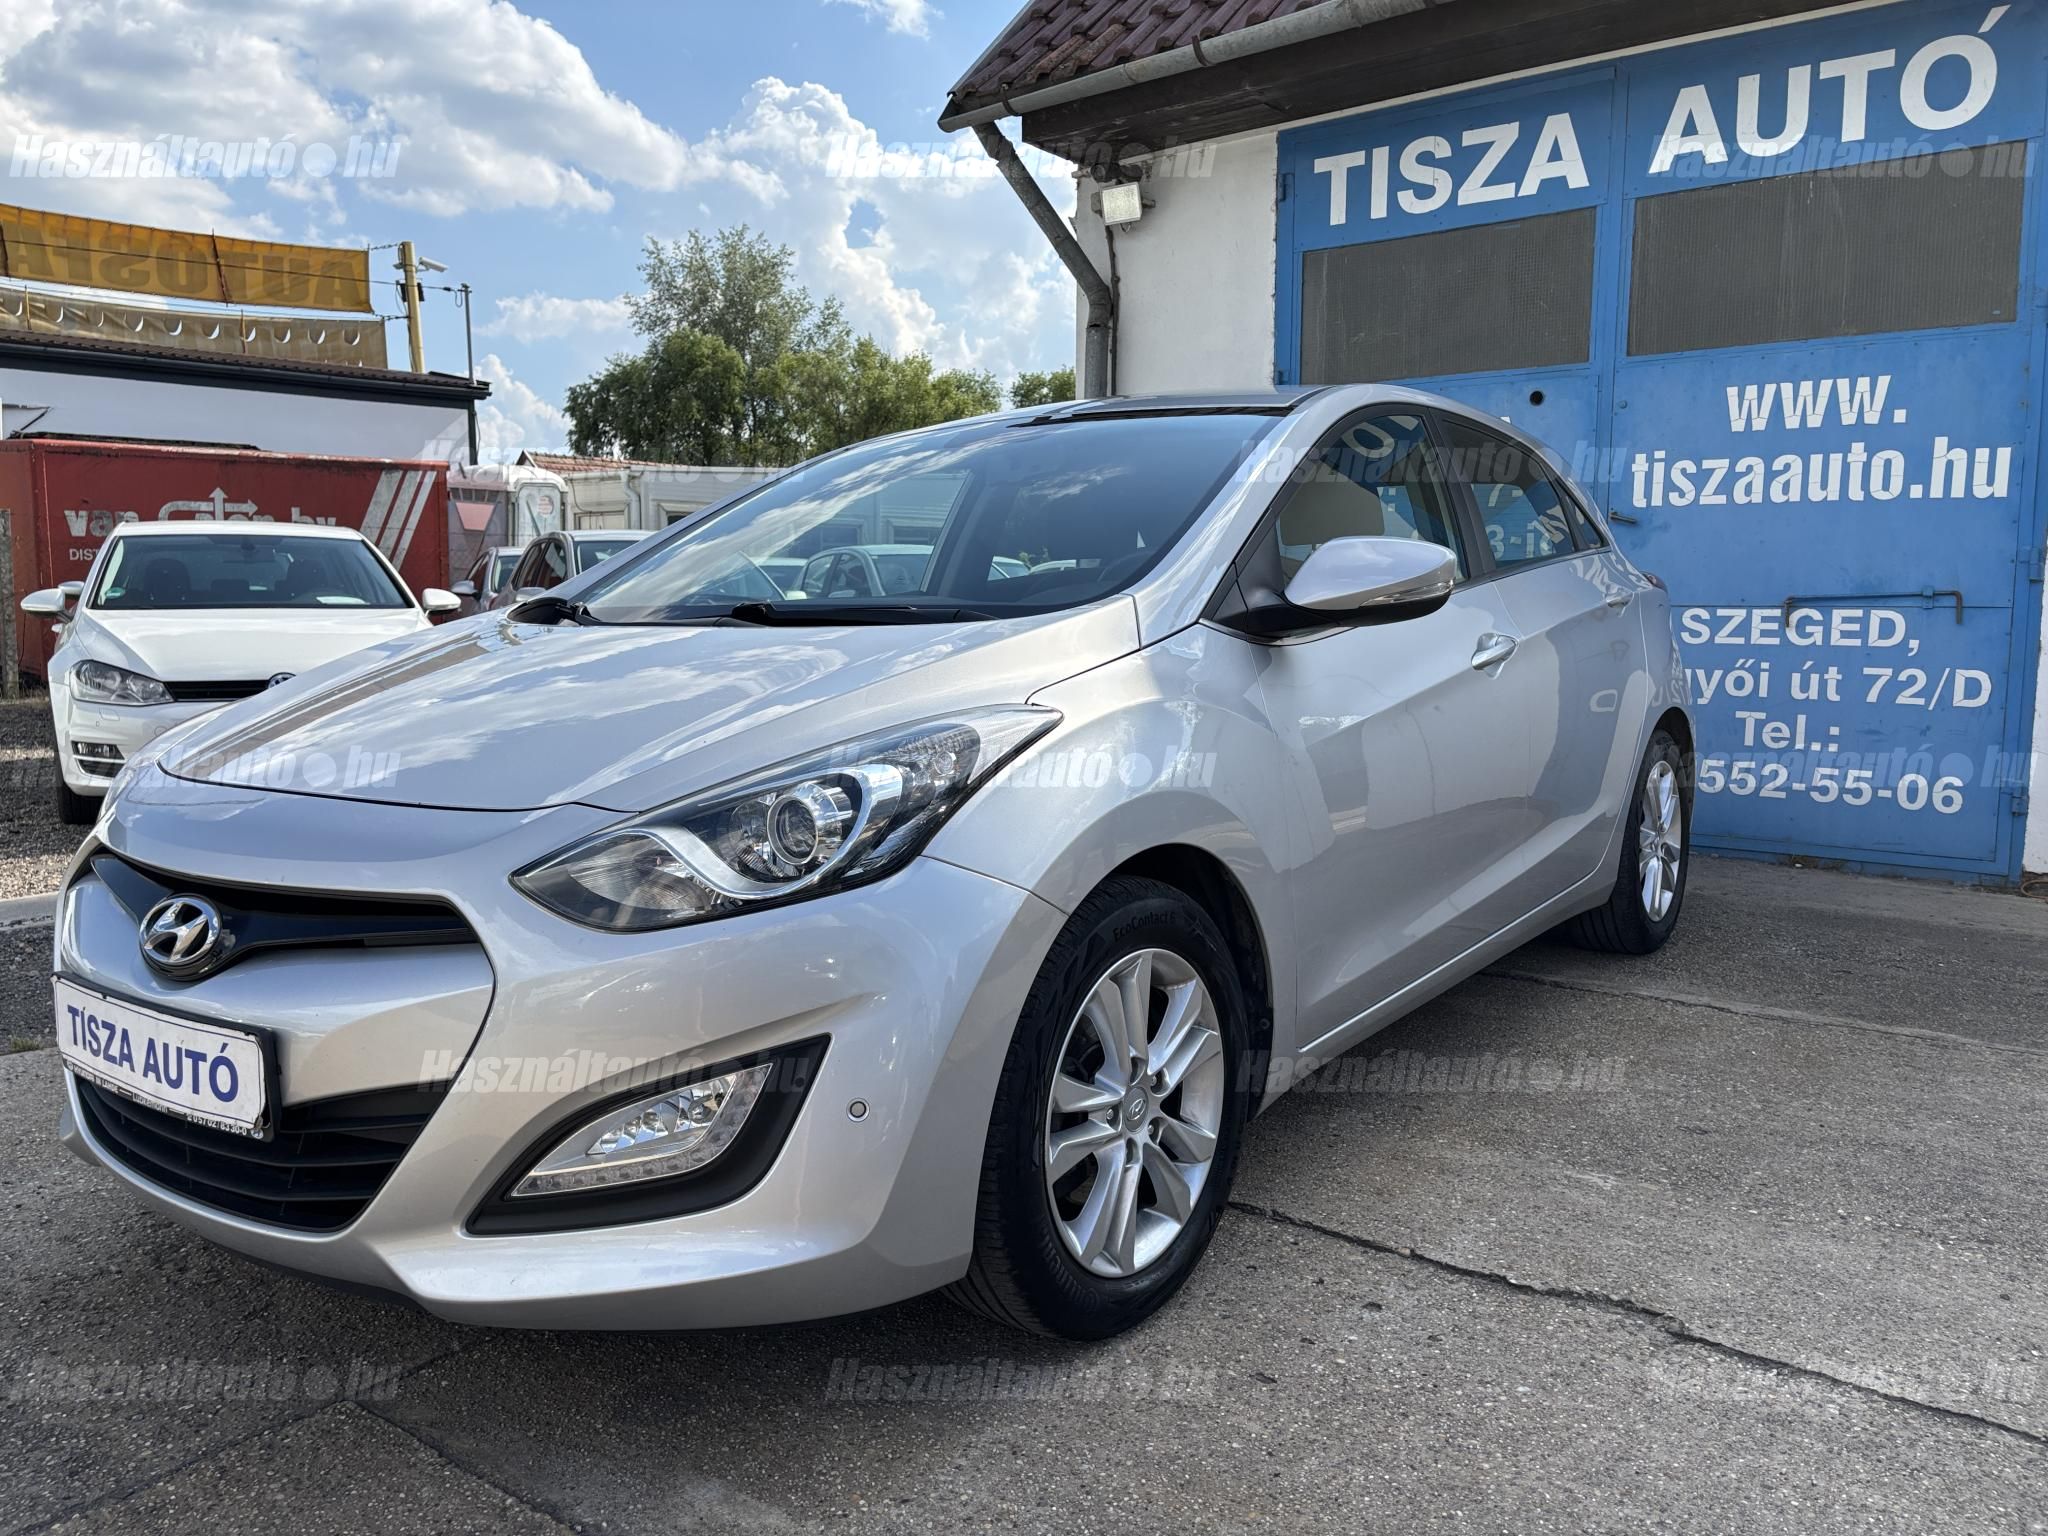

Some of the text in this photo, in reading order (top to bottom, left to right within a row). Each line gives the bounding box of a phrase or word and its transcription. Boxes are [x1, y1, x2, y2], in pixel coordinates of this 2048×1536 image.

[1313, 6, 2009, 226] TISZA AUTÓ
[1726, 375, 1907, 432] www.
[1632, 436, 2012, 508] tiszaauto.hu
[1680, 608, 1920, 657] SZEGED,
[1790, 660, 1843, 702] út
[1862, 667, 1993, 711] 72/D
[1735, 710, 1841, 752] Tel.:
[1697, 759, 1964, 814] 552-55-06
[143, 1036, 239, 1103] AUTÓ
